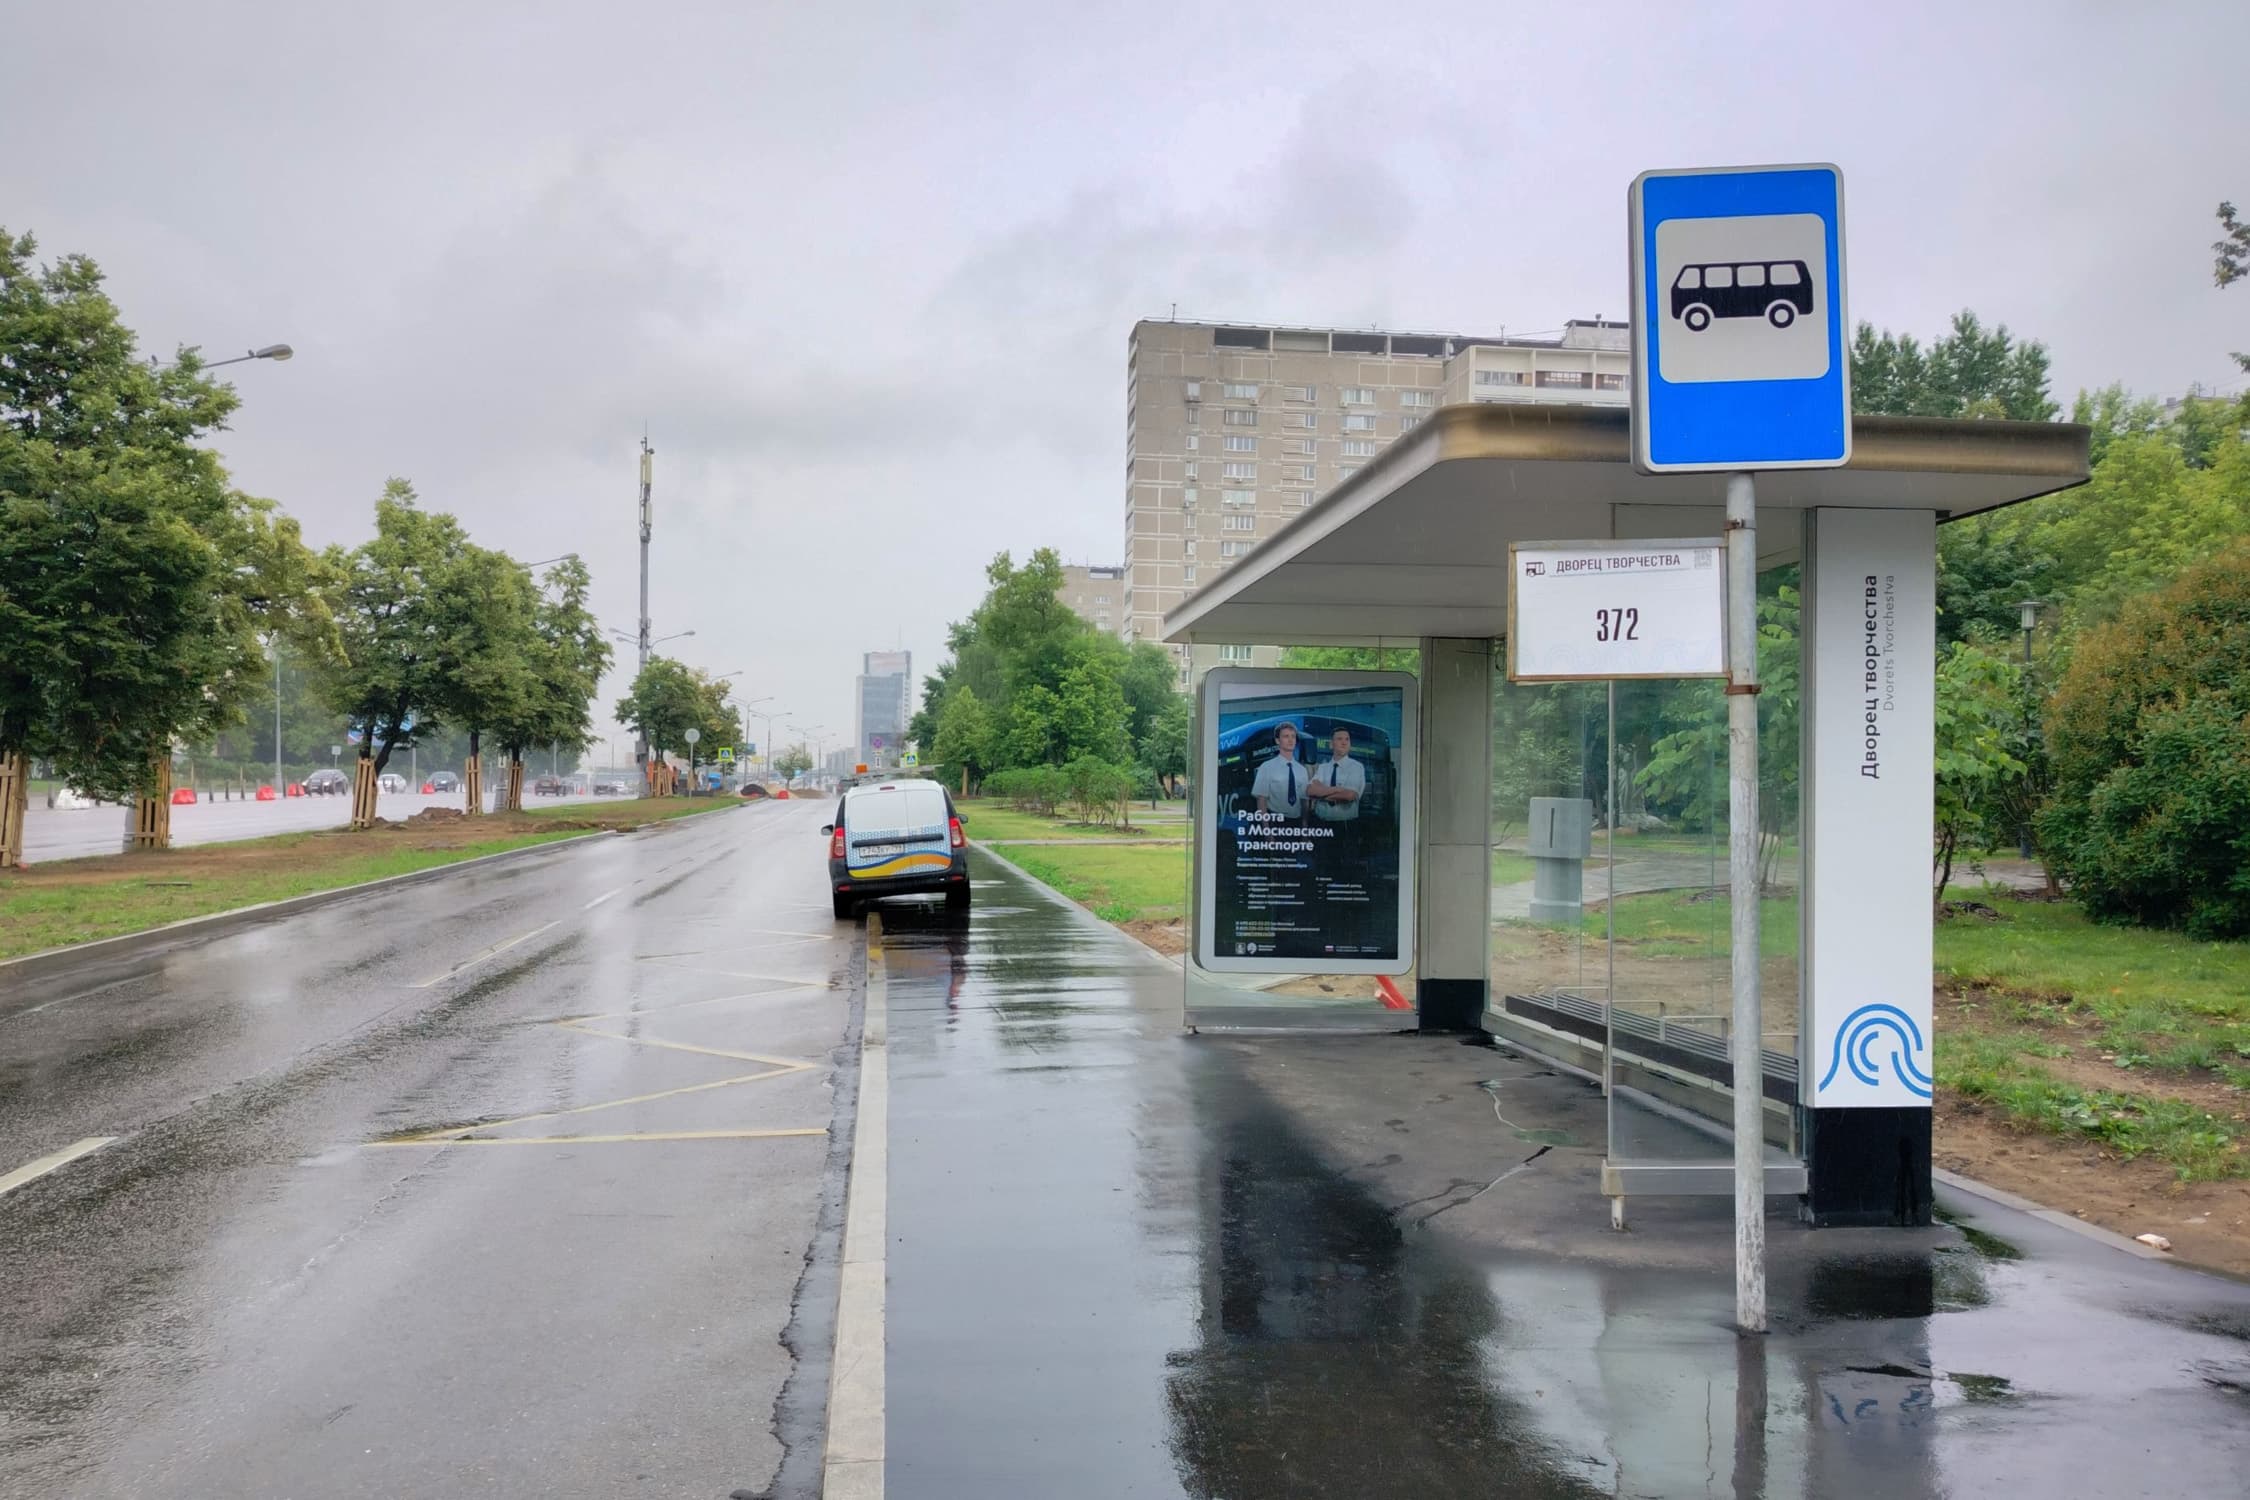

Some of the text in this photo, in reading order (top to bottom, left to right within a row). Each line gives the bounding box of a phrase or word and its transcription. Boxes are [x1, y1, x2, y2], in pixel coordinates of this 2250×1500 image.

[1556, 554, 1681, 573] ДВОРЕЦ ТВОРЧЕСТВА
[1596, 607, 1639, 642] 372
[1883, 575, 1894, 712] Dvorets Tvorchestva
[1862, 575, 1881, 779] Дворец творчества
[1237, 810, 1285, 823] Работа
[1237, 825, 1334, 838] в Московском
[1237, 839, 1315, 854] транспорте
